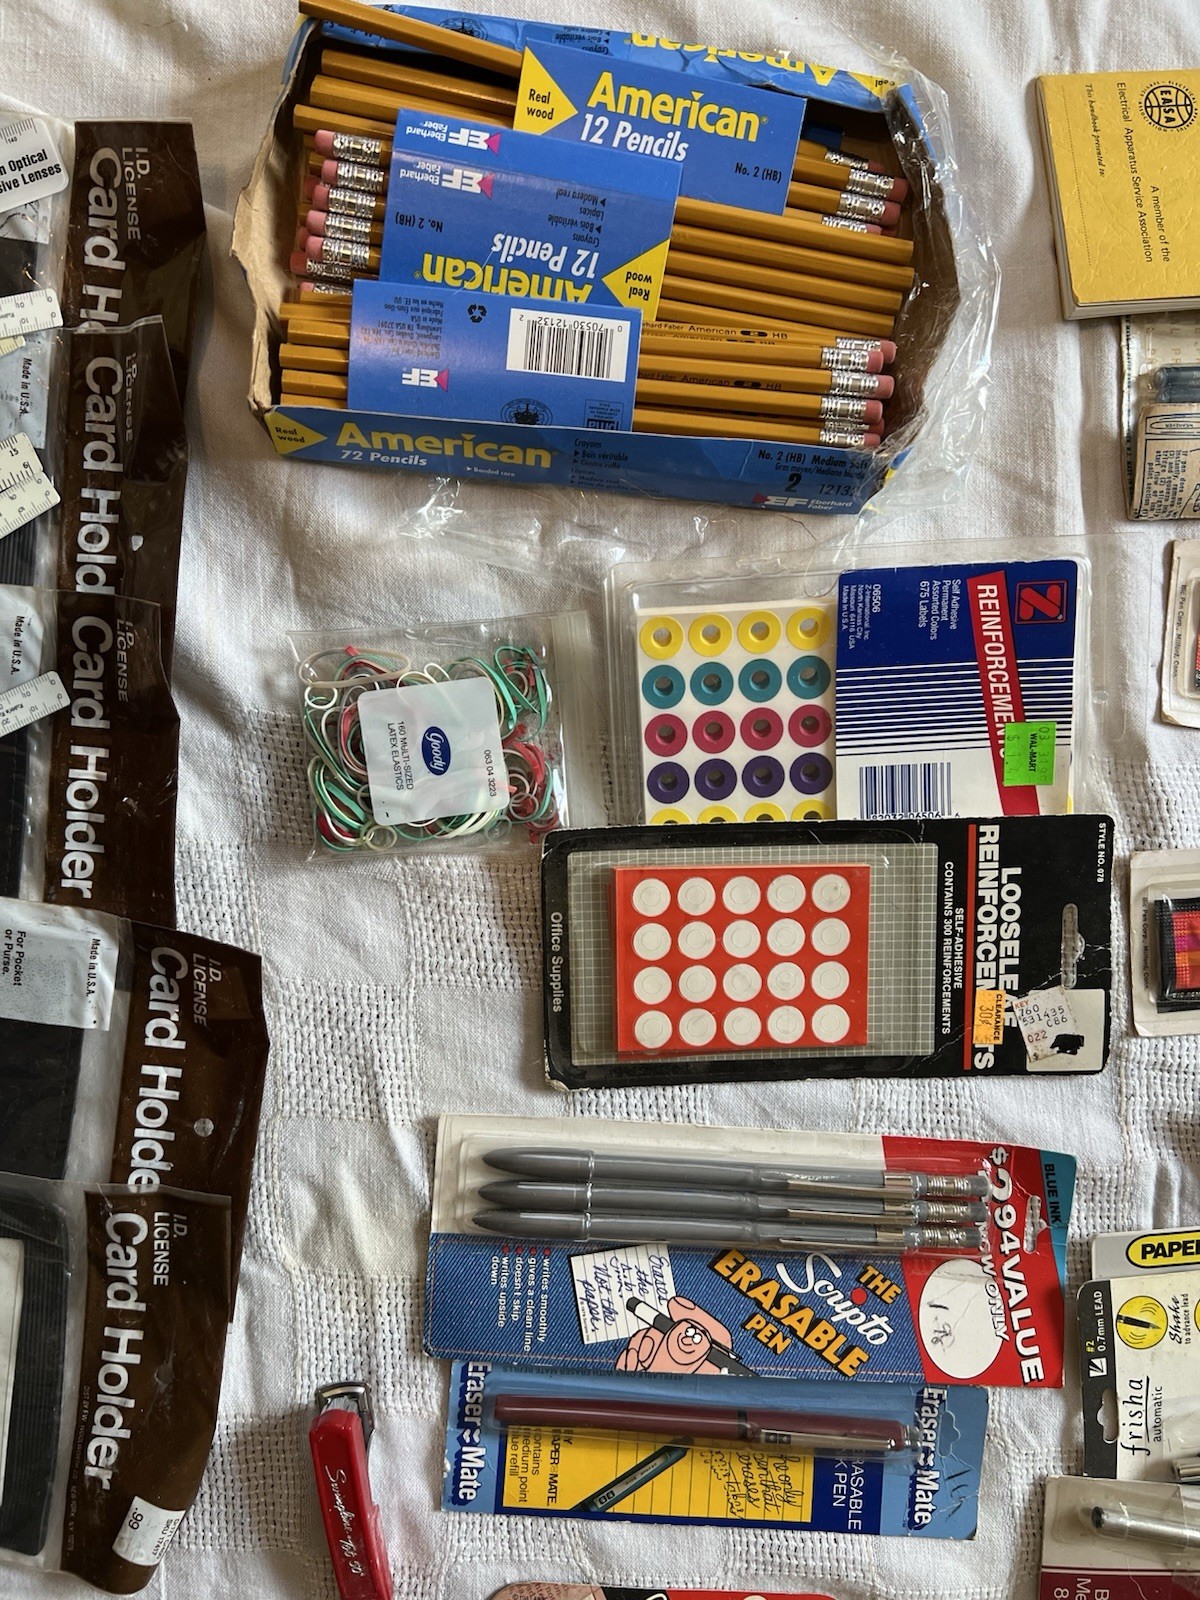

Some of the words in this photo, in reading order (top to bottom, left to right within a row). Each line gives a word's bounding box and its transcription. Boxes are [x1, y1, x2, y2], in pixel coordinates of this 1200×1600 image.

[528, 88, 552, 105] Real
[587, 71, 759, 142] American
[1160, 89, 1176, 123] EASA
[423, 120, 448, 133] Faber
[526, 105, 554, 120] wood
[1087, 98, 1101, 133] handbook
[406, 125, 447, 142] Eberhard
[580, 113, 608, 144] 12
[612, 118, 690, 162] Pencils
[8, 149, 49, 172] Optical
[21, 162, 62, 186] Lenses
[134, 147, 150, 180] I.D.
[415, 160, 441, 175] Faber
[735, 162, 751, 175] No.
[761, 167, 782, 184] (HB)
[1116, 82, 1132, 123] Electrical
[1124, 127, 1138, 174] Apparatus
[1131, 176, 1143, 208] Service
[1138, 210, 1153, 263] Association
[399, 168, 440, 185] Eberhard
[83, 146, 127, 271] Card
[121, 147, 141, 241] LICENSE
[395, 213, 415, 228] (HB)
[428, 218, 444, 233] No.
[1152, 196, 1165, 233] member
[491, 232, 567, 272] Pencils
[1159, 235, 1169, 245] of
[1161, 246, 1170, 262] the
[422, 252, 594, 302] American
[573, 248, 600, 278] 12
[625, 270, 653, 284] wood
[628, 285, 650, 300] Real
[537, 316, 567, 327] 12132
[572, 320, 604, 332] 70530
[688, 325, 737, 336] American
[22, 357, 33, 380] Made
[681, 374, 730, 387] American
[23, 381, 29, 390] in
[19, 391, 30, 416] U.S.A.
[82, 355, 124, 473] Card
[275, 426, 298, 436] Real
[277, 434, 306, 444] wood
[335, 422, 552, 469] American
[340, 450, 364, 461] 72
[370, 451, 428, 466] Pencils
[758, 449, 774, 461] No.
[776, 451, 784, 462] 2
[785, 451, 806, 465] (HB)
[811, 454, 846, 468] Medium
[784, 473, 802, 492] 2
[75, 487, 122, 595] Hold
[872, 583, 882, 613] 06506
[919, 580, 929, 598] 675
[930, 579, 941, 614] Assorted
[940, 579, 950, 621] Permanent
[951, 578, 961, 595] Self
[856, 603, 864, 626] Kansas
[918, 600, 928, 629] Labels
[949, 596, 960, 630] Adhesive
[1178, 596, 1186, 610] Pen
[13, 615, 25, 640] Made
[929, 616, 940, 641] Colors
[10, 649, 23, 675] U.S.A.
[70, 615, 114, 729] Card
[116, 618, 129, 703] LICENSE
[387, 722, 398, 750] LATEX
[397, 721, 405, 734] 160
[399, 734, 414, 790] MULTI-SIZED
[426, 731, 446, 773] Goody
[483, 749, 492, 764] 063
[1028, 732, 1038, 773] WAL-MART
[391, 751, 404, 791] ELASTICS
[485, 765, 494, 775] 04
[487, 777, 497, 797] 3223
[60, 744, 110, 899] Holder
[1097, 822, 1107, 850] STYLE
[1097, 851, 1106, 867] NO.
[943, 861, 954, 916] CONTAINS
[1096, 868, 1105, 883] 078
[5, 928, 13, 941] or
[15, 930, 26, 949] For
[550, 911, 564, 952] Office
[942, 917, 953, 936] 300
[2, 940, 13, 975] Purse.
[90, 938, 101, 960] Made
[953, 907, 965, 989] SELF-ADHESIVE
[974, 824, 1000, 1069] REINFORCETS
[12, 949, 26, 987] Pocket
[89, 961, 98, 970] in
[208, 957, 222, 983] I.D.
[85, 971, 98, 998] U.S.A.
[144, 946, 189, 1050] Card
[192, 952, 208, 1027] LICENSE
[549, 954, 565, 1013] Supplies
[941, 937, 952, 1035] REINFORCEMENTS
[993, 993, 1003, 1041] CLEARANCE
[1014, 999, 1029, 1010] KEY
[1018, 1003, 1040, 1018] 760
[1027, 1032, 1048, 1044] 022
[128, 1064, 183, 1194] Holde
[1043, 1162, 1057, 1198] BLUE
[170, 1212, 188, 1240] I.D.
[1049, 1199, 1062, 1224] INK
[104, 1211, 148, 1312] Card
[152, 1210, 170, 1287] LICENSE
[490, 1255, 499, 1286] down
[500, 1256, 510, 1290] writes
[512, 1256, 523, 1299] doesn't
[527, 1257, 537, 1290] gives
[541, 1258, 551, 1291] writes
[857, 1264, 902, 1305] THE
[497, 1291, 508, 1328] upside
[510, 1300, 520, 1322] skip
[709, 1249, 871, 1377] ERASABLE
[775, 1251, 894, 1346] Scripto
[984, 1279, 1010, 1341] ONLY
[1094, 1290, 1103, 1318] LEAD
[1181, 1293, 1189, 1305] lead
[536, 1291, 549, 1344] smoothly
[1001, 1254, 1045, 1384] VALUE
[1169, 1294, 1183, 1345] Shake
[1183, 1306, 1191, 1335] advance
[523, 1330, 532, 1352] line
[743, 1313, 793, 1355] PEN
[1085, 1340, 1095, 1353] #2
[1096, 1320, 1106, 1352] 0.7mm
[83, 1326, 145, 1491] Holder
[465, 1361, 493, 1432] Eraser
[917, 1387, 949, 1450] Eraser
[1121, 1378, 1151, 1456] frisha
[1153, 1385, 1163, 1443] automatic
[508, 1455, 518, 1477] refill
[519, 1428, 530, 1474] medium
[531, 1428, 541, 1476] contains
[458, 1445, 487, 1501] Mate
[517, 1476, 528, 1503] point
[832, 1471, 848, 1508] PEN
[914, 1468, 941, 1526] Mate
[128, 1507, 144, 1530] .99
